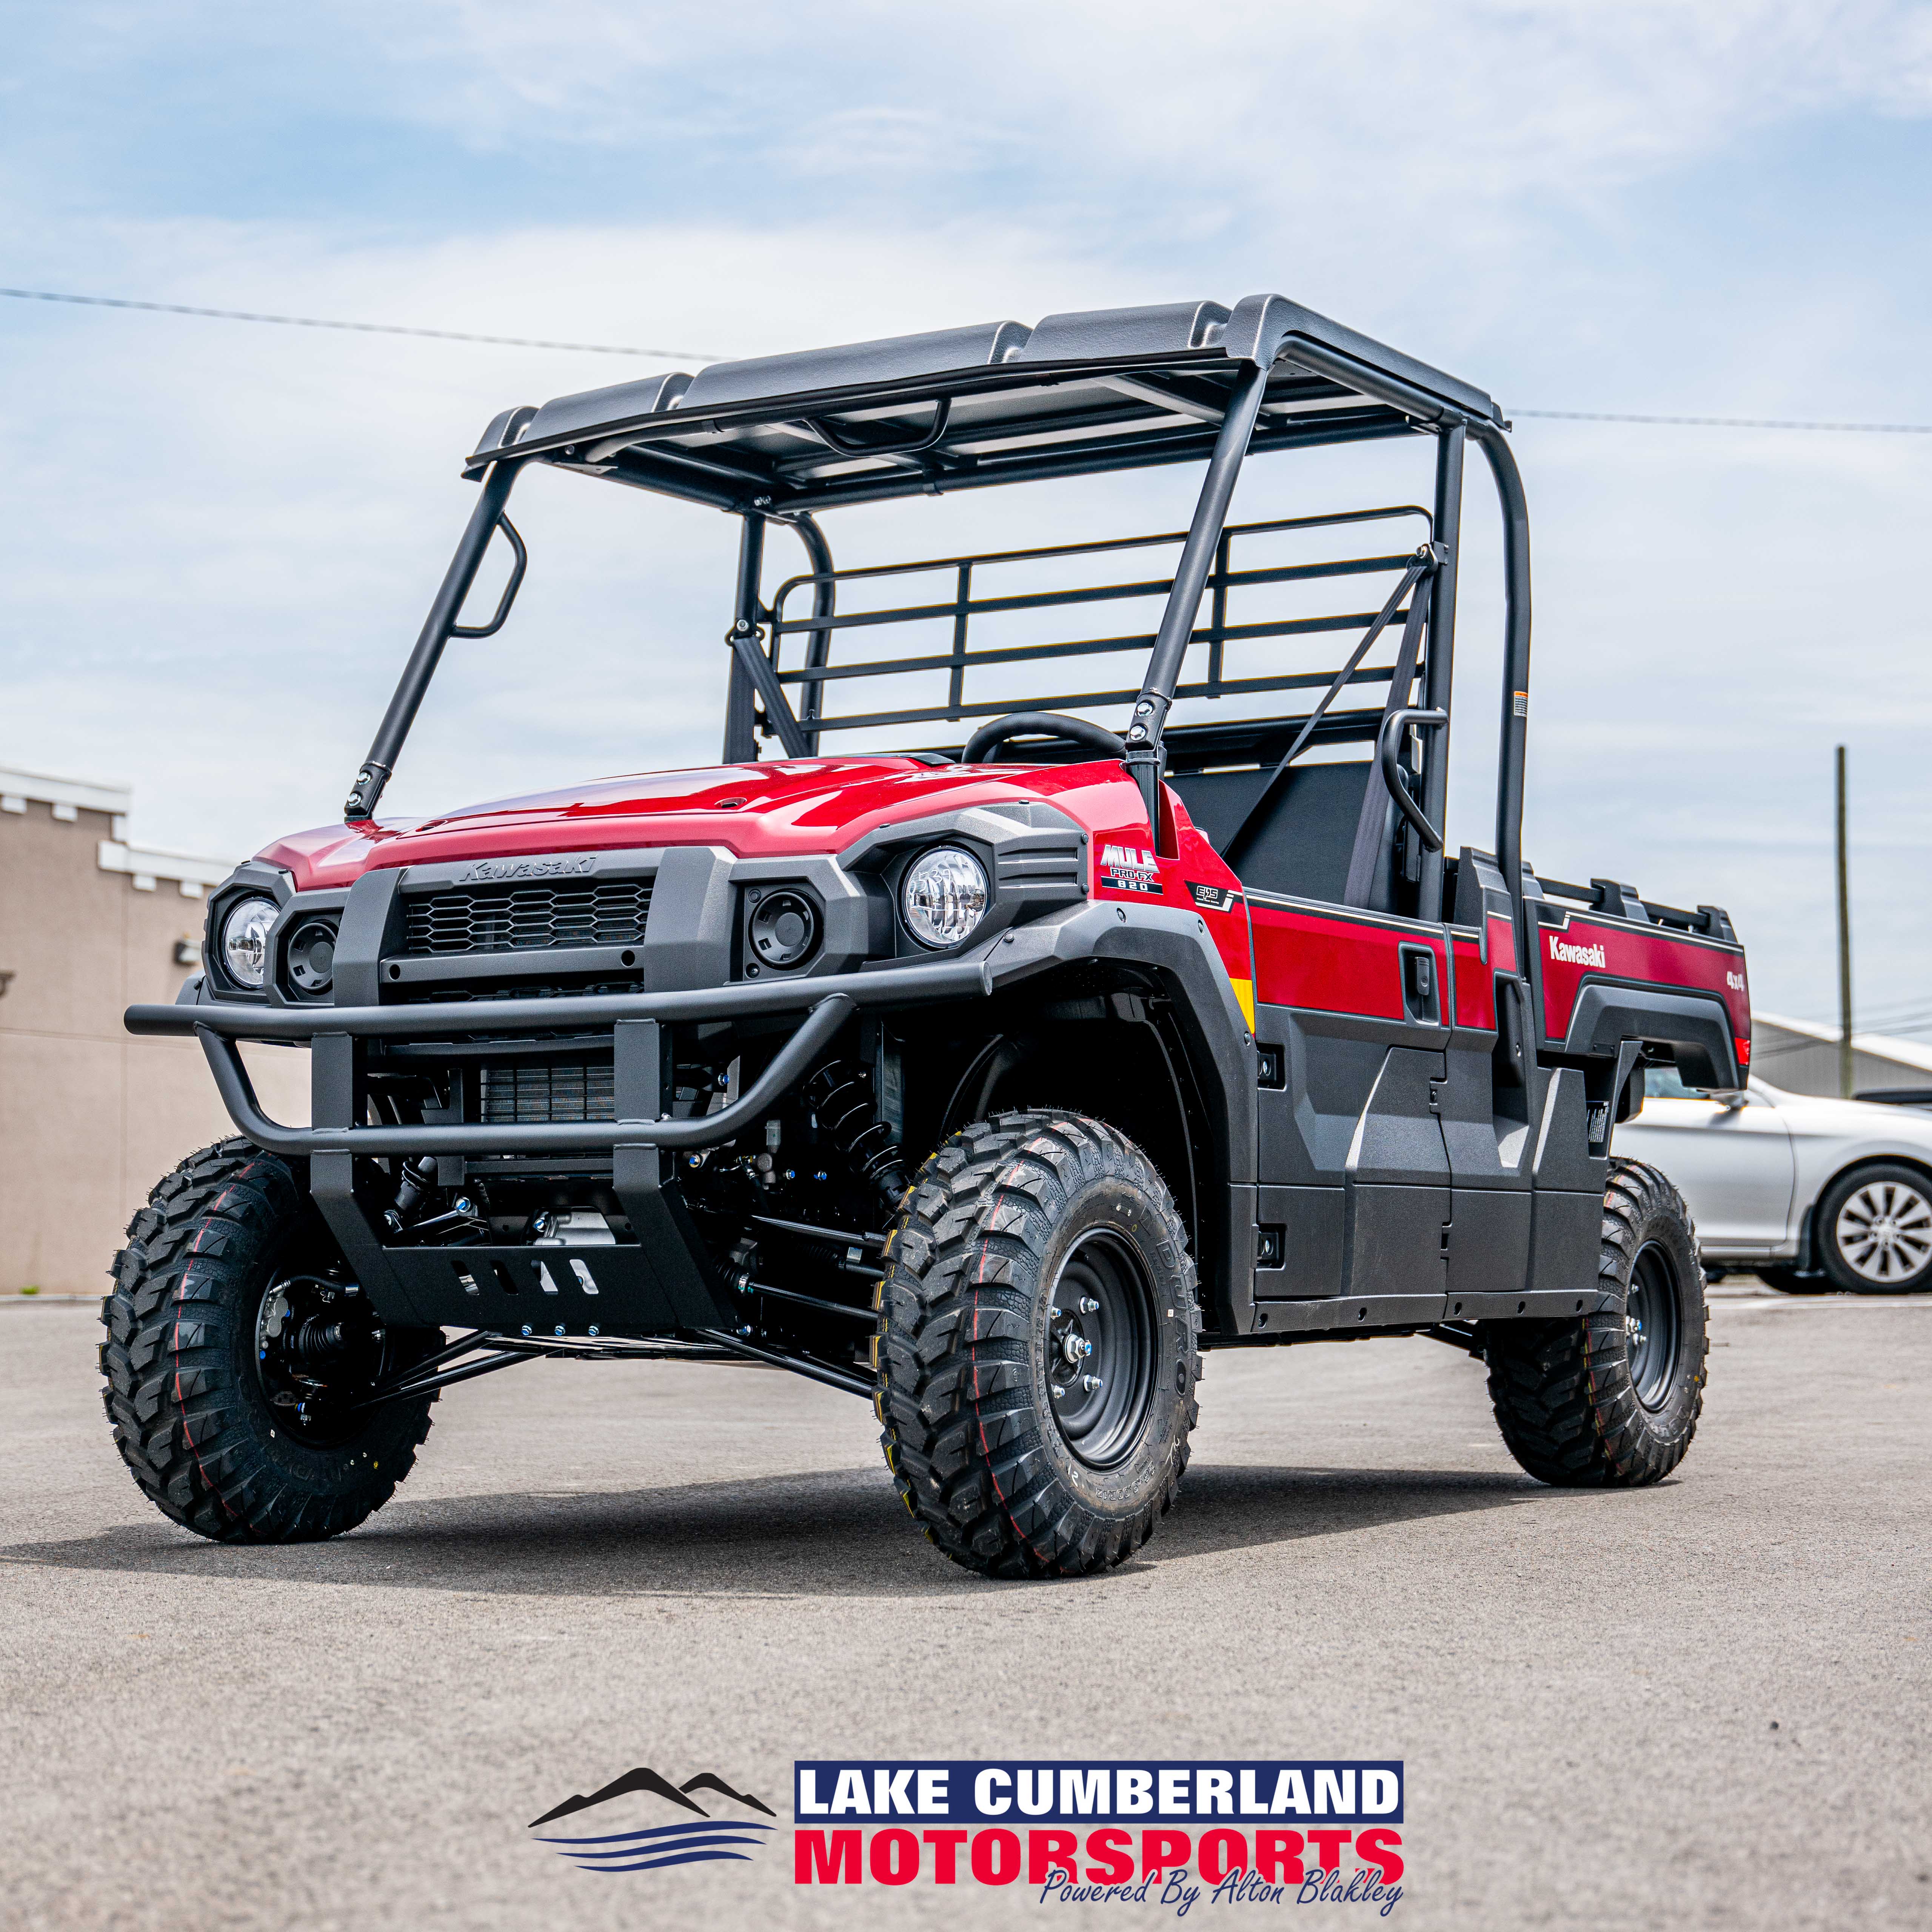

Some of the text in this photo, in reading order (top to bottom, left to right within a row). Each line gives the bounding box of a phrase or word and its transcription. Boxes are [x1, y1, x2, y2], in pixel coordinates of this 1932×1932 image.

[459, 854, 598, 881] Kawasaki
[1100, 844, 1160, 873] MULE
[1110, 867, 1155, 882] PRO-FX
[1118, 880, 1148, 891] 820
[1196, 886, 1218, 899] EPS
[1549, 935, 1606, 968] Kawasaki
[1727, 971, 1744, 991] 4x4
[1156, 1239, 1188, 1397] DURO
